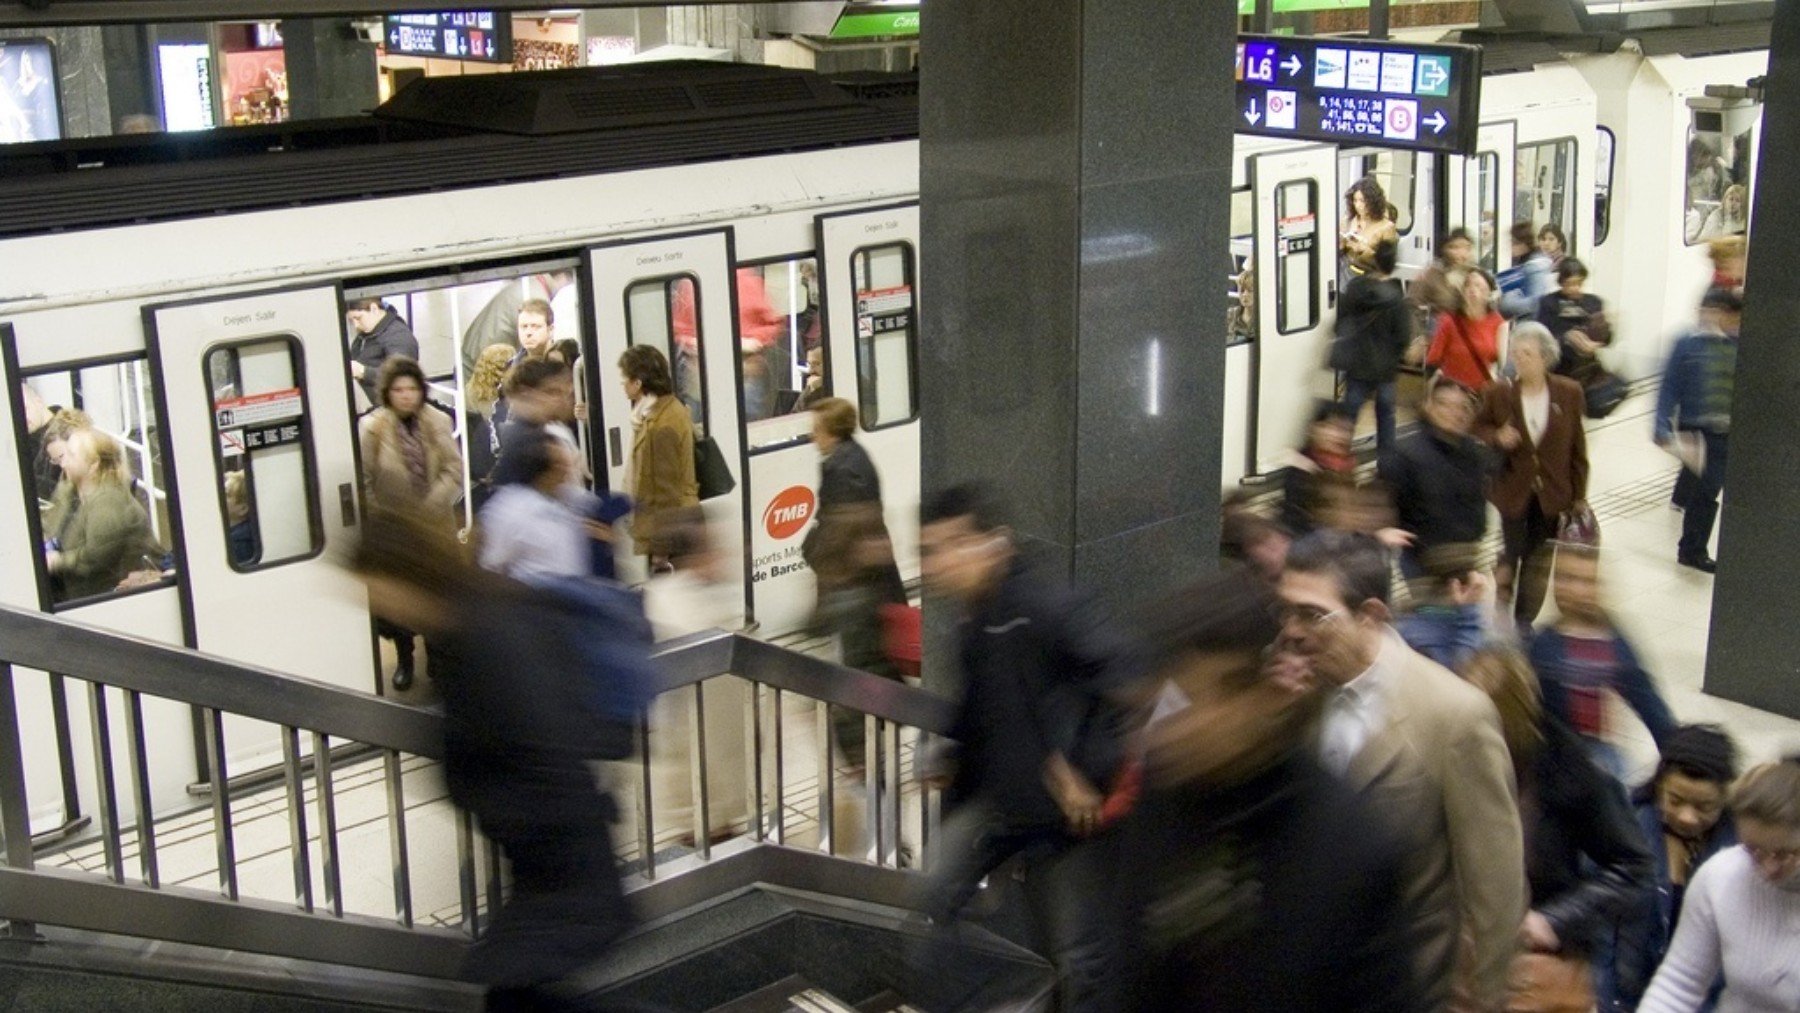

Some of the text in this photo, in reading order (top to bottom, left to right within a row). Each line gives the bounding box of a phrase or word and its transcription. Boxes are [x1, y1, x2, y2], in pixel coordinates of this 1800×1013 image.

[1248, 55, 1272, 80] L6
[223, 309, 276, 327] Dejen Salir
[773, 502, 810, 526] TMB
[752, 560, 806, 583] de Barce
